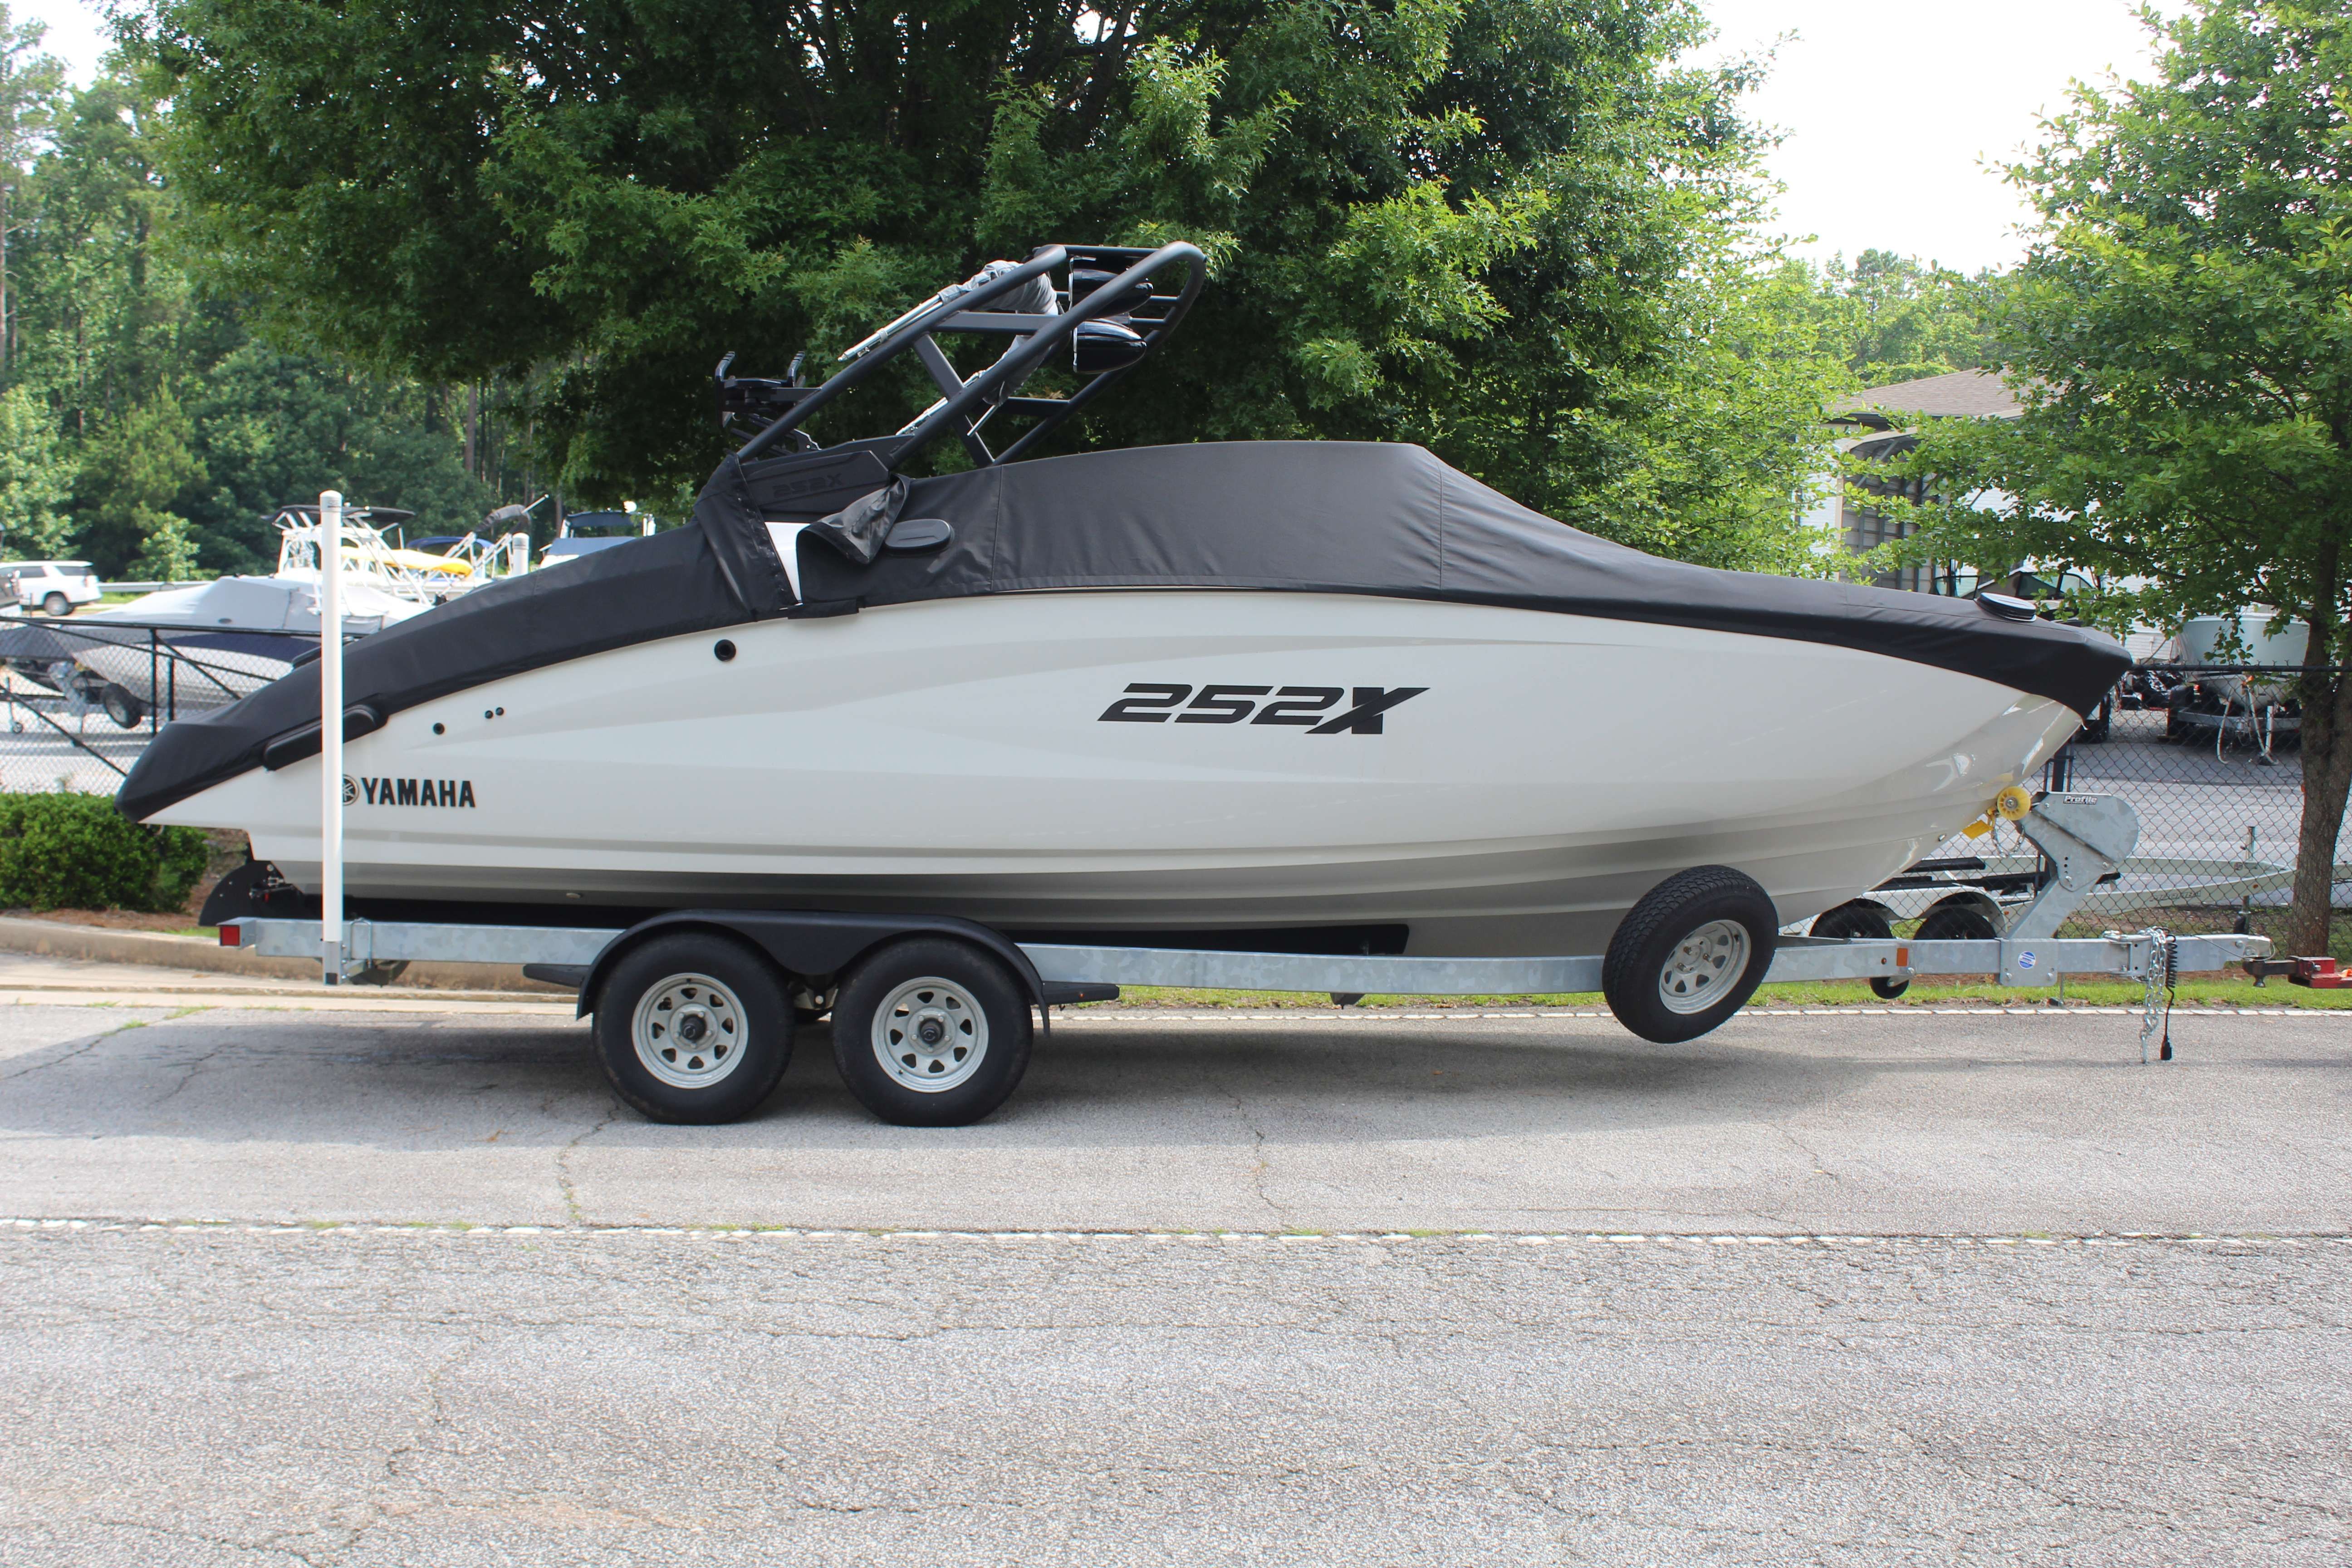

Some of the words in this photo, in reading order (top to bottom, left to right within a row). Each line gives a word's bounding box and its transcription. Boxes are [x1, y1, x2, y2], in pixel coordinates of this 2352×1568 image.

[772, 473, 844, 498] 252X
[1097, 683, 1431, 734] 252X
[361, 777, 476, 808] YAMAHA
